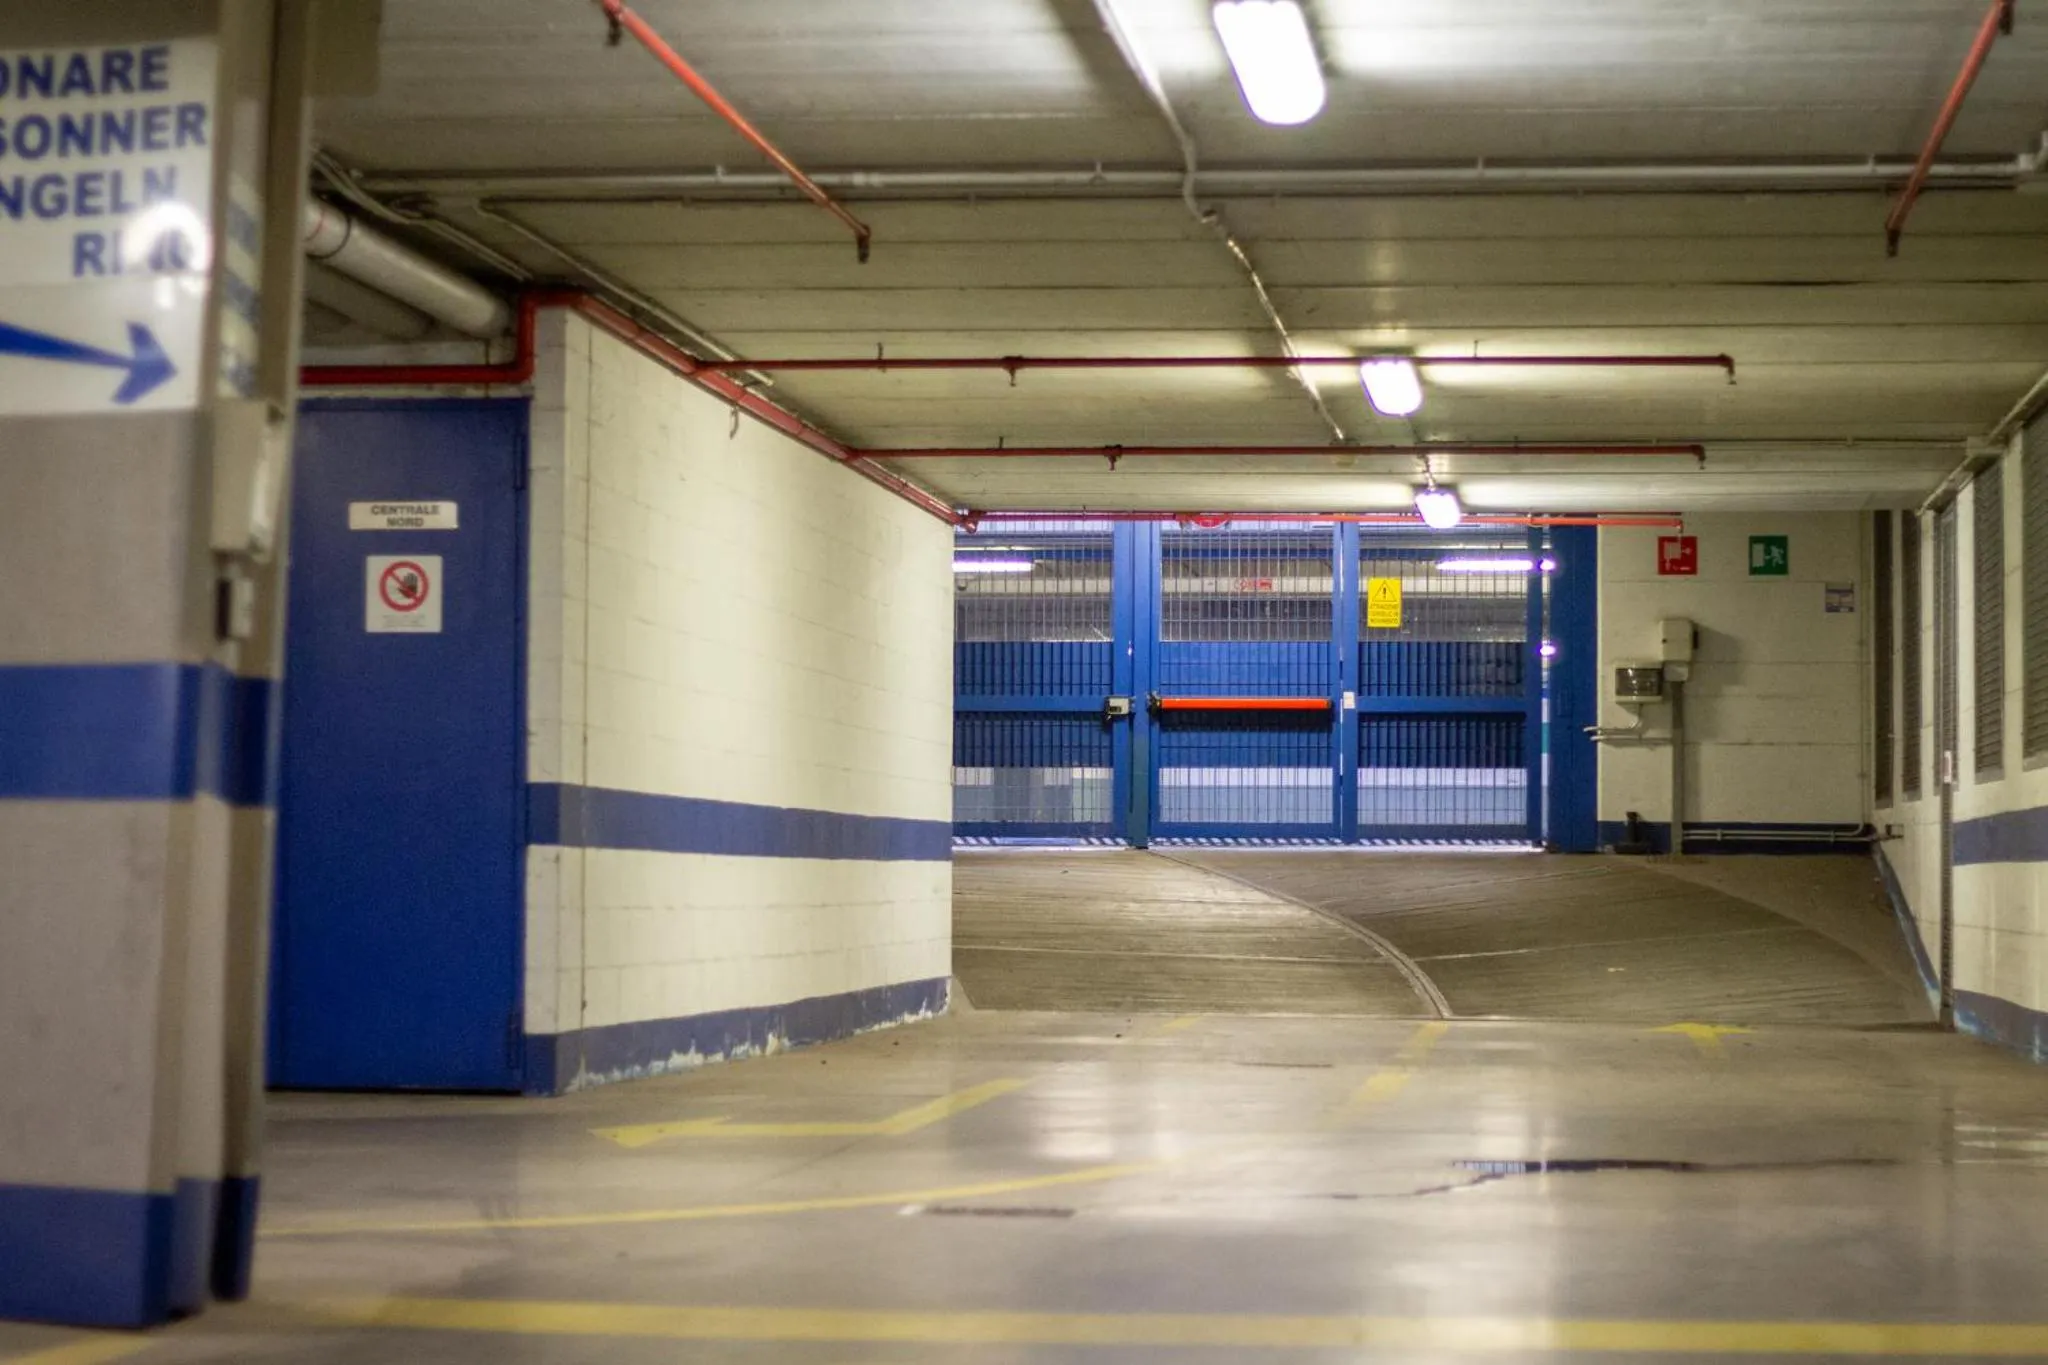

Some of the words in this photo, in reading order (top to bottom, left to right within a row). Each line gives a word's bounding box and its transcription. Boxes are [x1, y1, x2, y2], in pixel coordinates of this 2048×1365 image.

[0, 45, 171, 99] NARE
[0, 102, 207, 161] ONNER
[370, 504, 440, 516] CENTRALE
[386, 516, 424, 528] NORD
